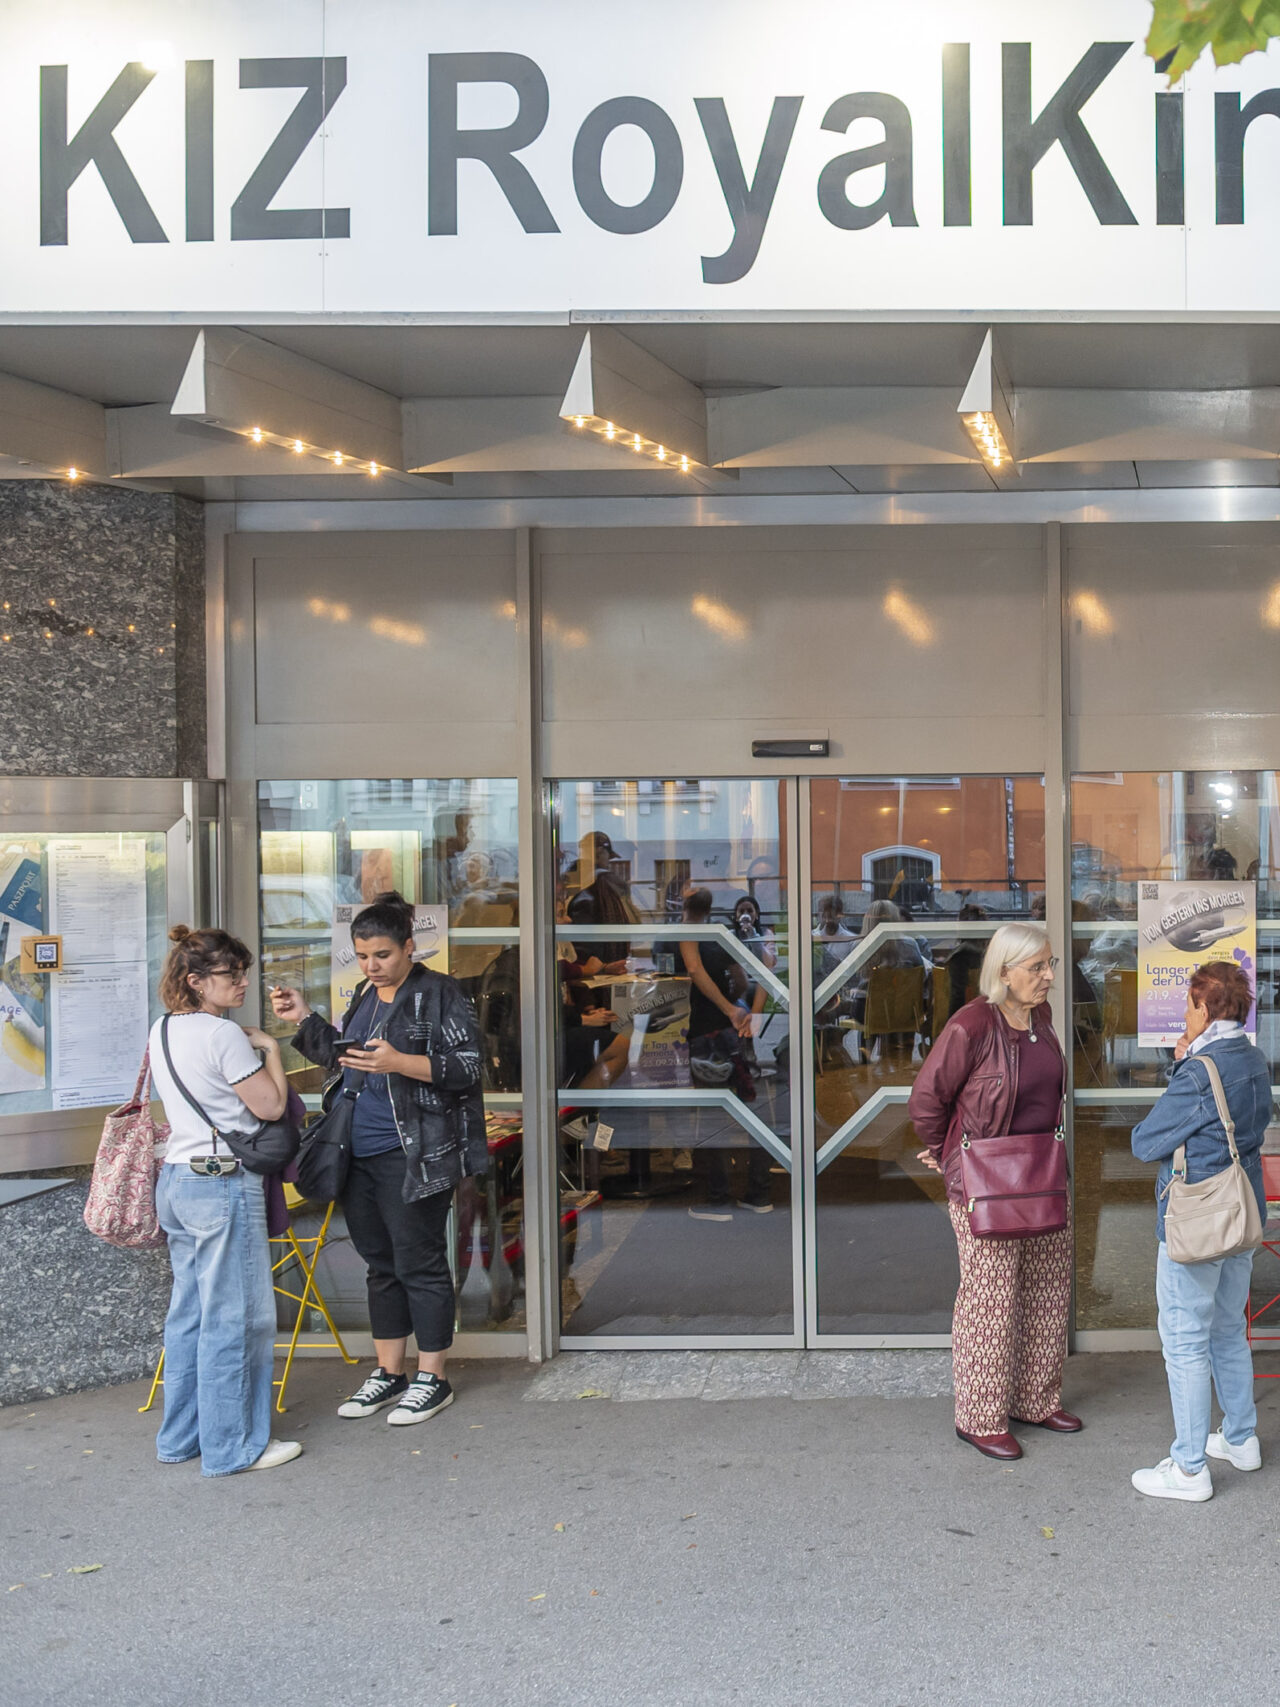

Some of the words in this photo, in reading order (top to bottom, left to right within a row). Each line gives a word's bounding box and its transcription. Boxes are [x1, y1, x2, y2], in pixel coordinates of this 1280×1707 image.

[39, 56, 351, 247] KIZ
[1142, 922, 1162, 943] VON
[1161, 904, 1195, 930] GESTERN
[1193, 897, 1210, 914] INS
[1208, 891, 1245, 909] MORGEN
[1146, 964, 1190, 977] Langer
[1153, 974, 1174, 985] der
